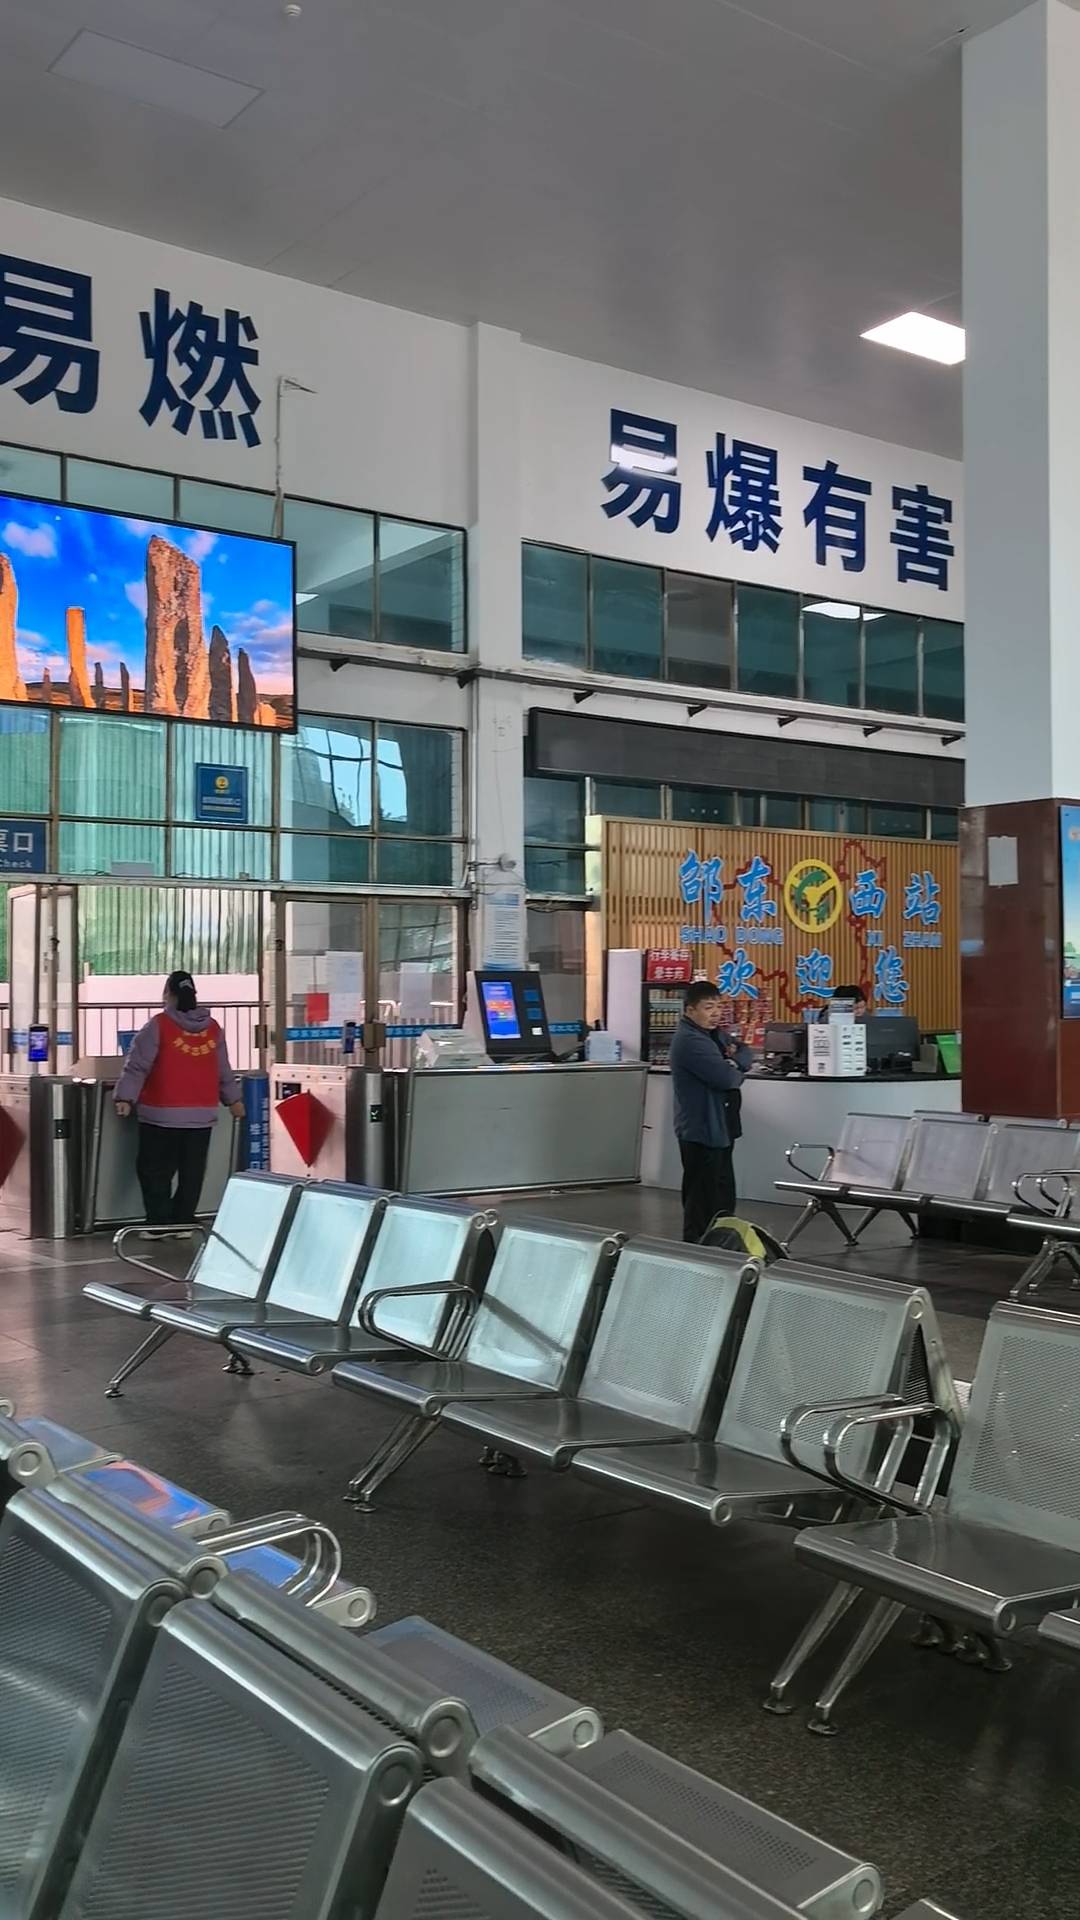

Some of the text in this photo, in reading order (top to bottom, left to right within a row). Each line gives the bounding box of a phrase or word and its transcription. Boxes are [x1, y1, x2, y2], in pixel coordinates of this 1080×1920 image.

[0, 253, 262, 448] 易燃
[600, 408, 955, 592] 易爆有害
[680, 924, 728, 944] SHAO
[717, 945, 910, 1004] 欢迎您
